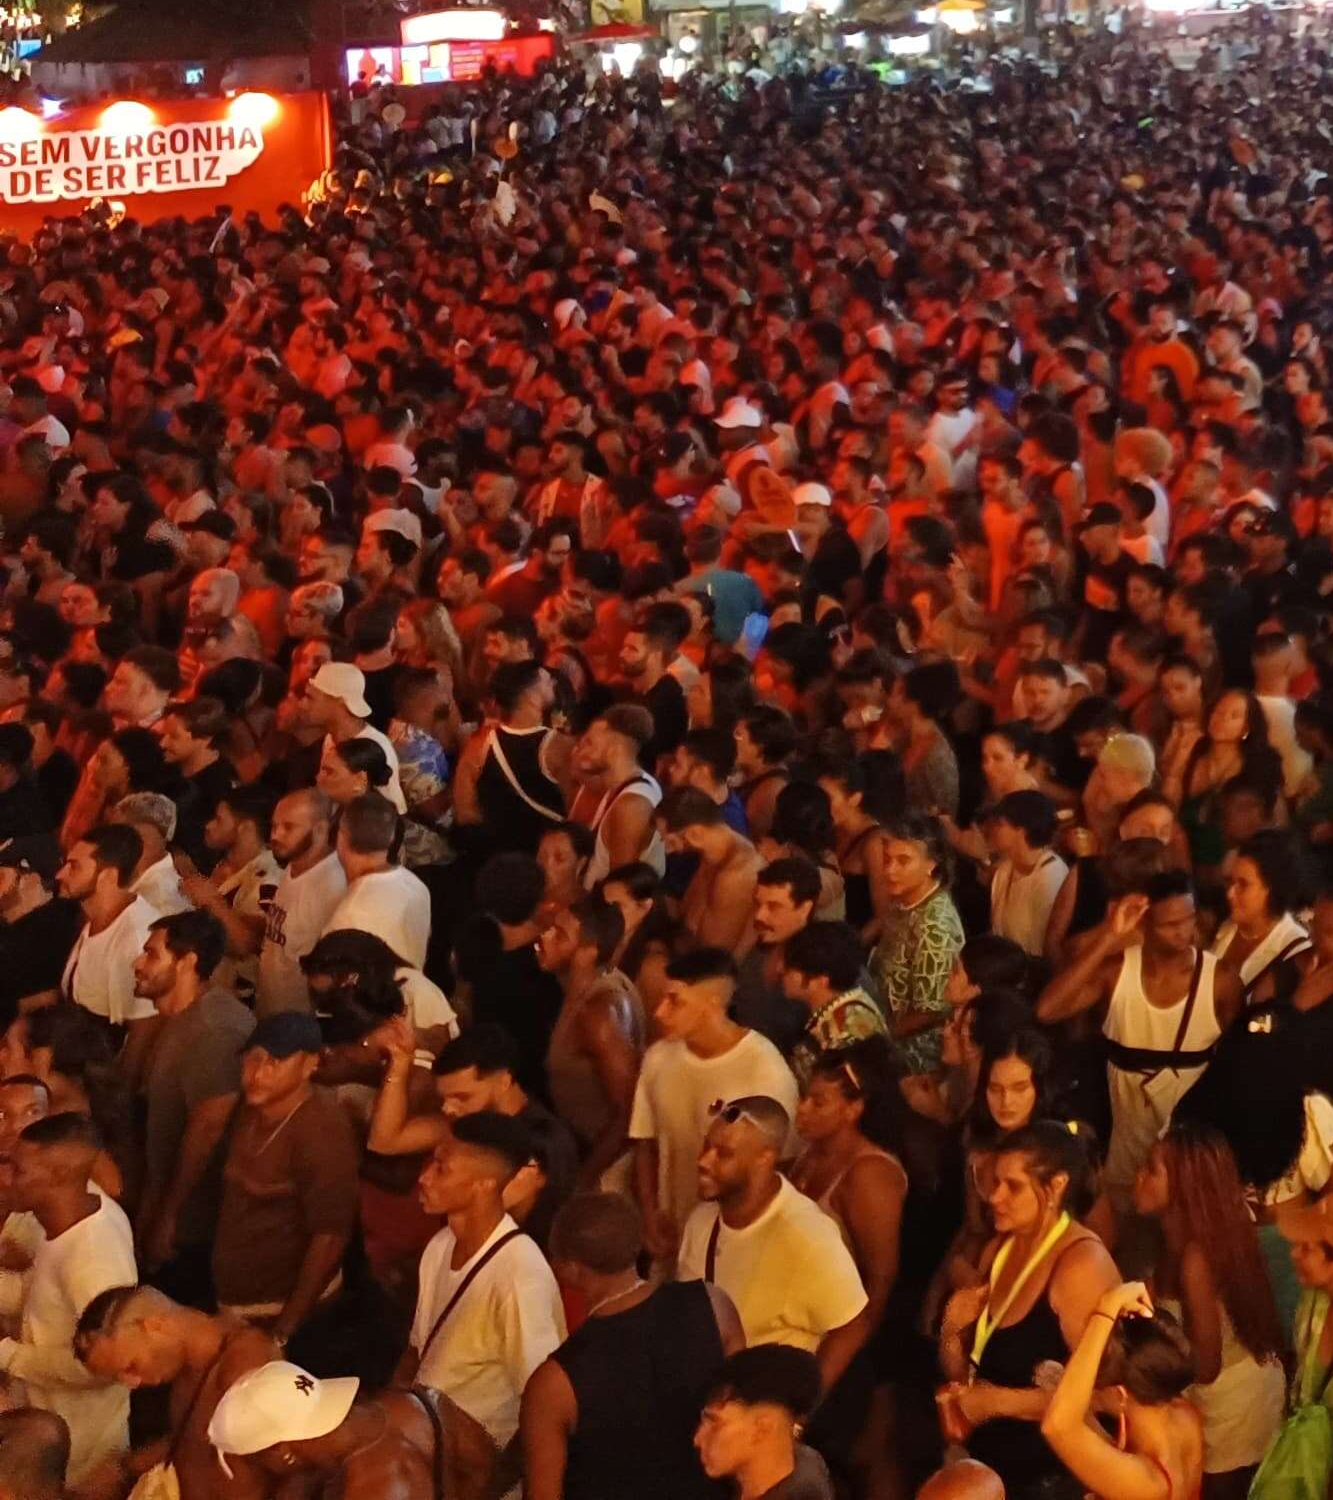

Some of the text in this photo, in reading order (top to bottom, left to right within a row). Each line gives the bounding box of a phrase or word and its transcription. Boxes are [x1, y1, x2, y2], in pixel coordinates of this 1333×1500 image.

[0, 126, 257, 167] SEM VERGONHA
[10, 156, 221, 197] DE SER FELIZ
